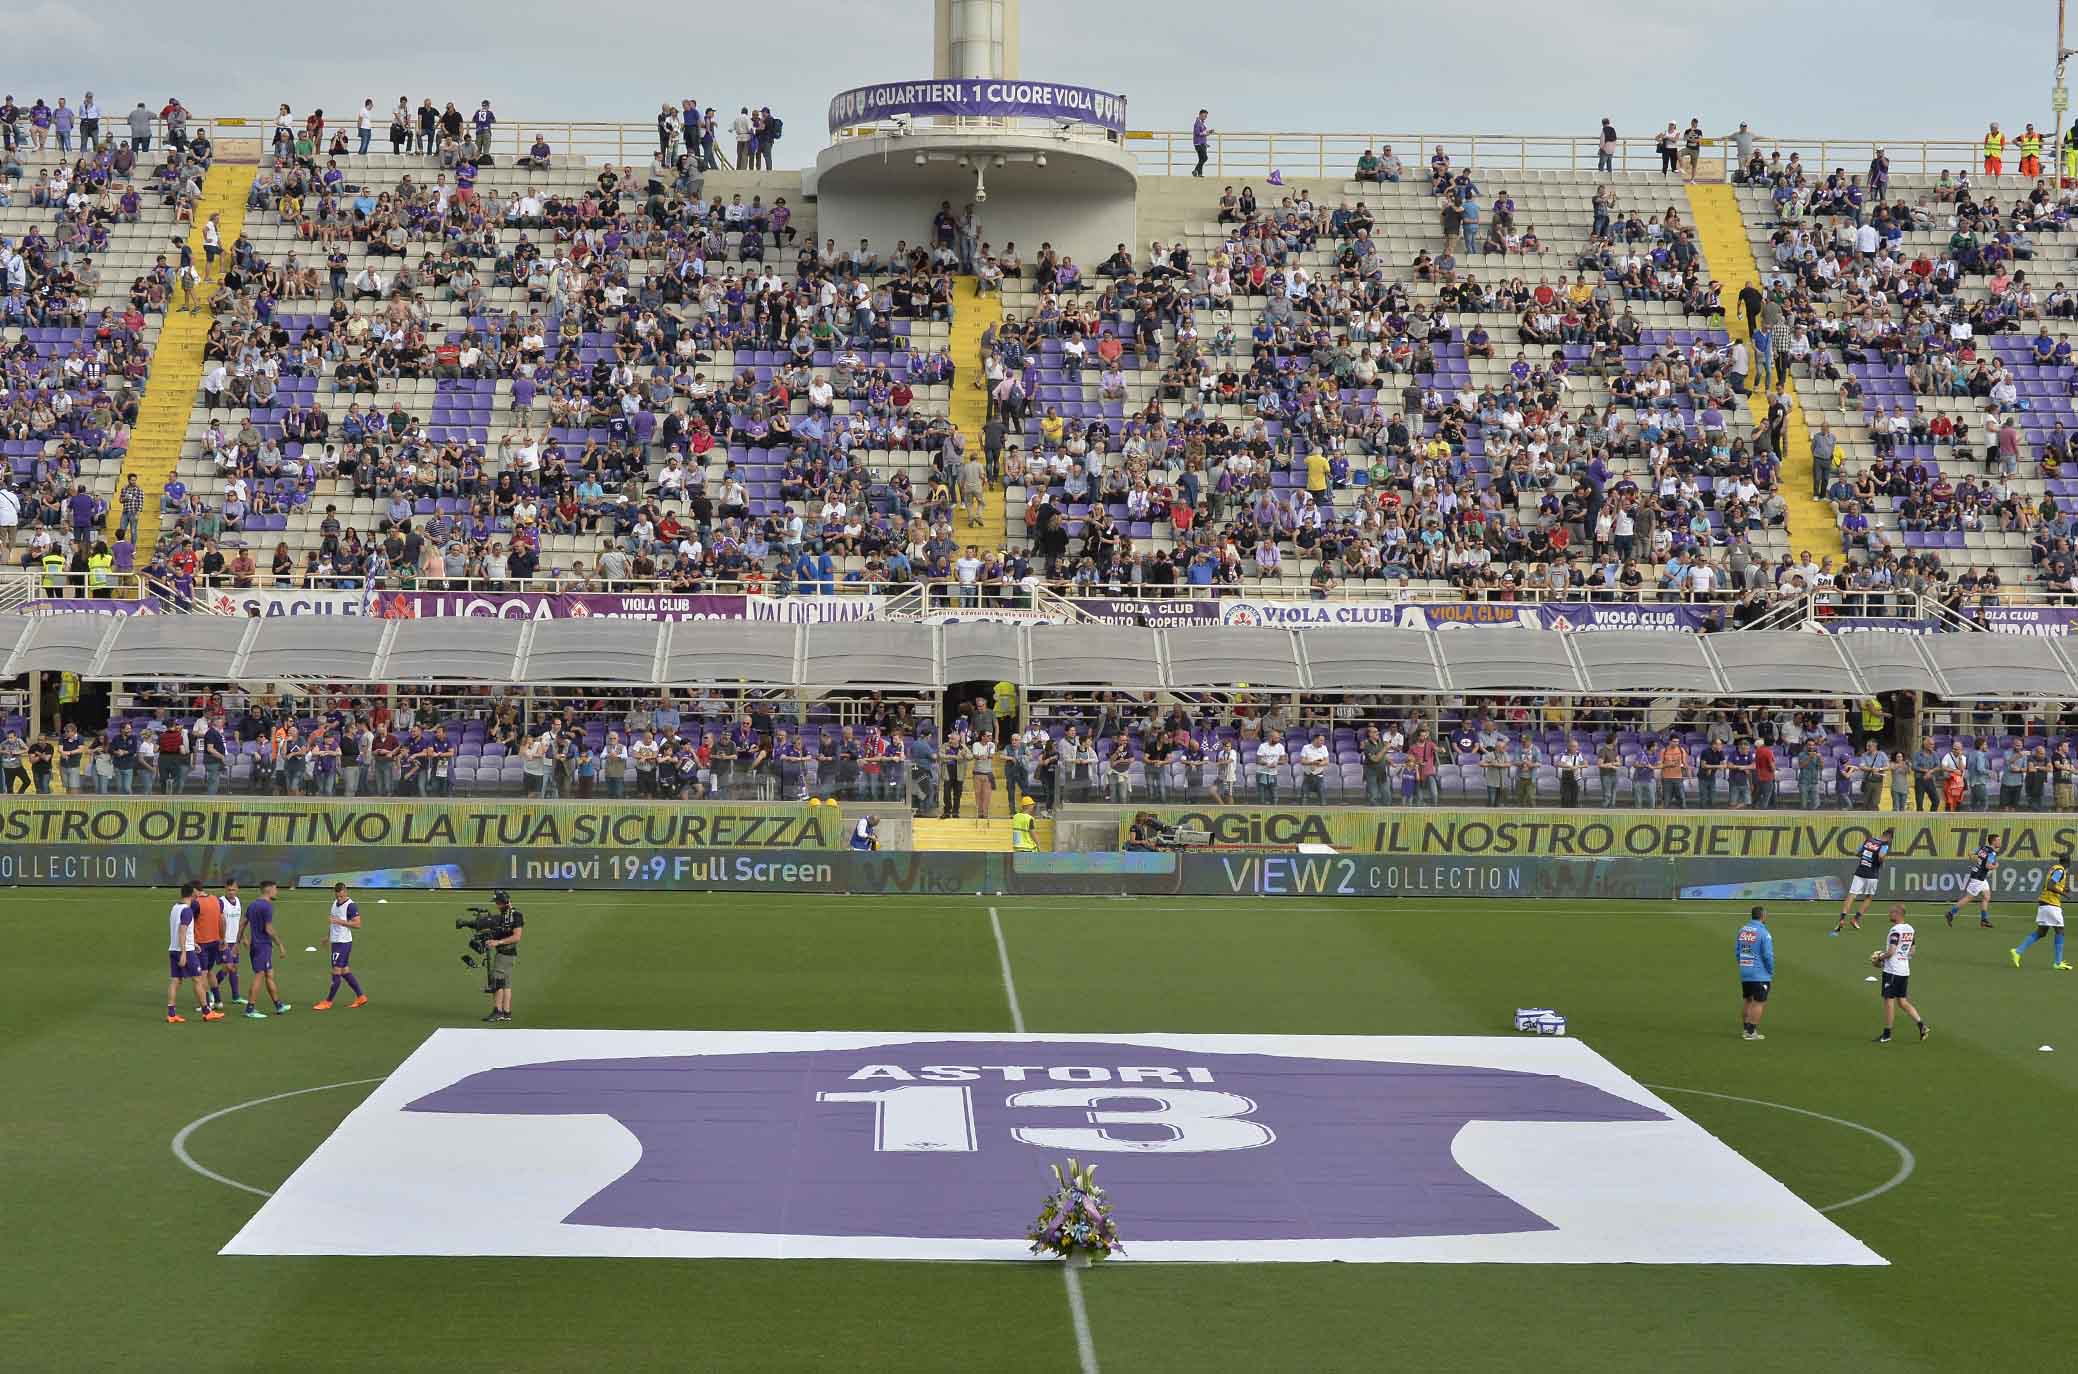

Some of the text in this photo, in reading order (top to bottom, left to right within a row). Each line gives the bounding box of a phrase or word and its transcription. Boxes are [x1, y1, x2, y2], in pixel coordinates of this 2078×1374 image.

[868, 84, 1092, 111] 4 QUARTIERI, 1 CUORE VIOLA
[622, 599, 690, 611] VIOLA CLUB
[1111, 603, 1194, 614] VIOLA CLUB
[1431, 606, 1474, 621] VIOLA
[1478, 606, 1514, 620] CLUB
[1145, 617, 1220, 629] OOPERATIVO
[1263, 607, 1330, 623] VIOLA
[1336, 607, 1393, 623] CLUB
[1594, 611, 1675, 625] VIOLA CLUB
[2010, 611, 2039, 621] CLUB
[0, 810, 827, 848] STRO OBIETTIVO LA TUA SICUREZZA
[1375, 822, 1410, 852] IL
[1421, 822, 1614, 854] NOSTRO
[1625, 824, 1873, 857] OBIETTIVO
[1950, 828, 2041, 858] TUA
[511, 854, 832, 883] I nuovi 19:9 Full Screen
[1370, 866, 1521, 890] COLLECTION
[1905, 871, 1971, 892] nuov
[848, 1064, 1216, 1083] ASTORI
[816, 1086, 1277, 1153] 13
